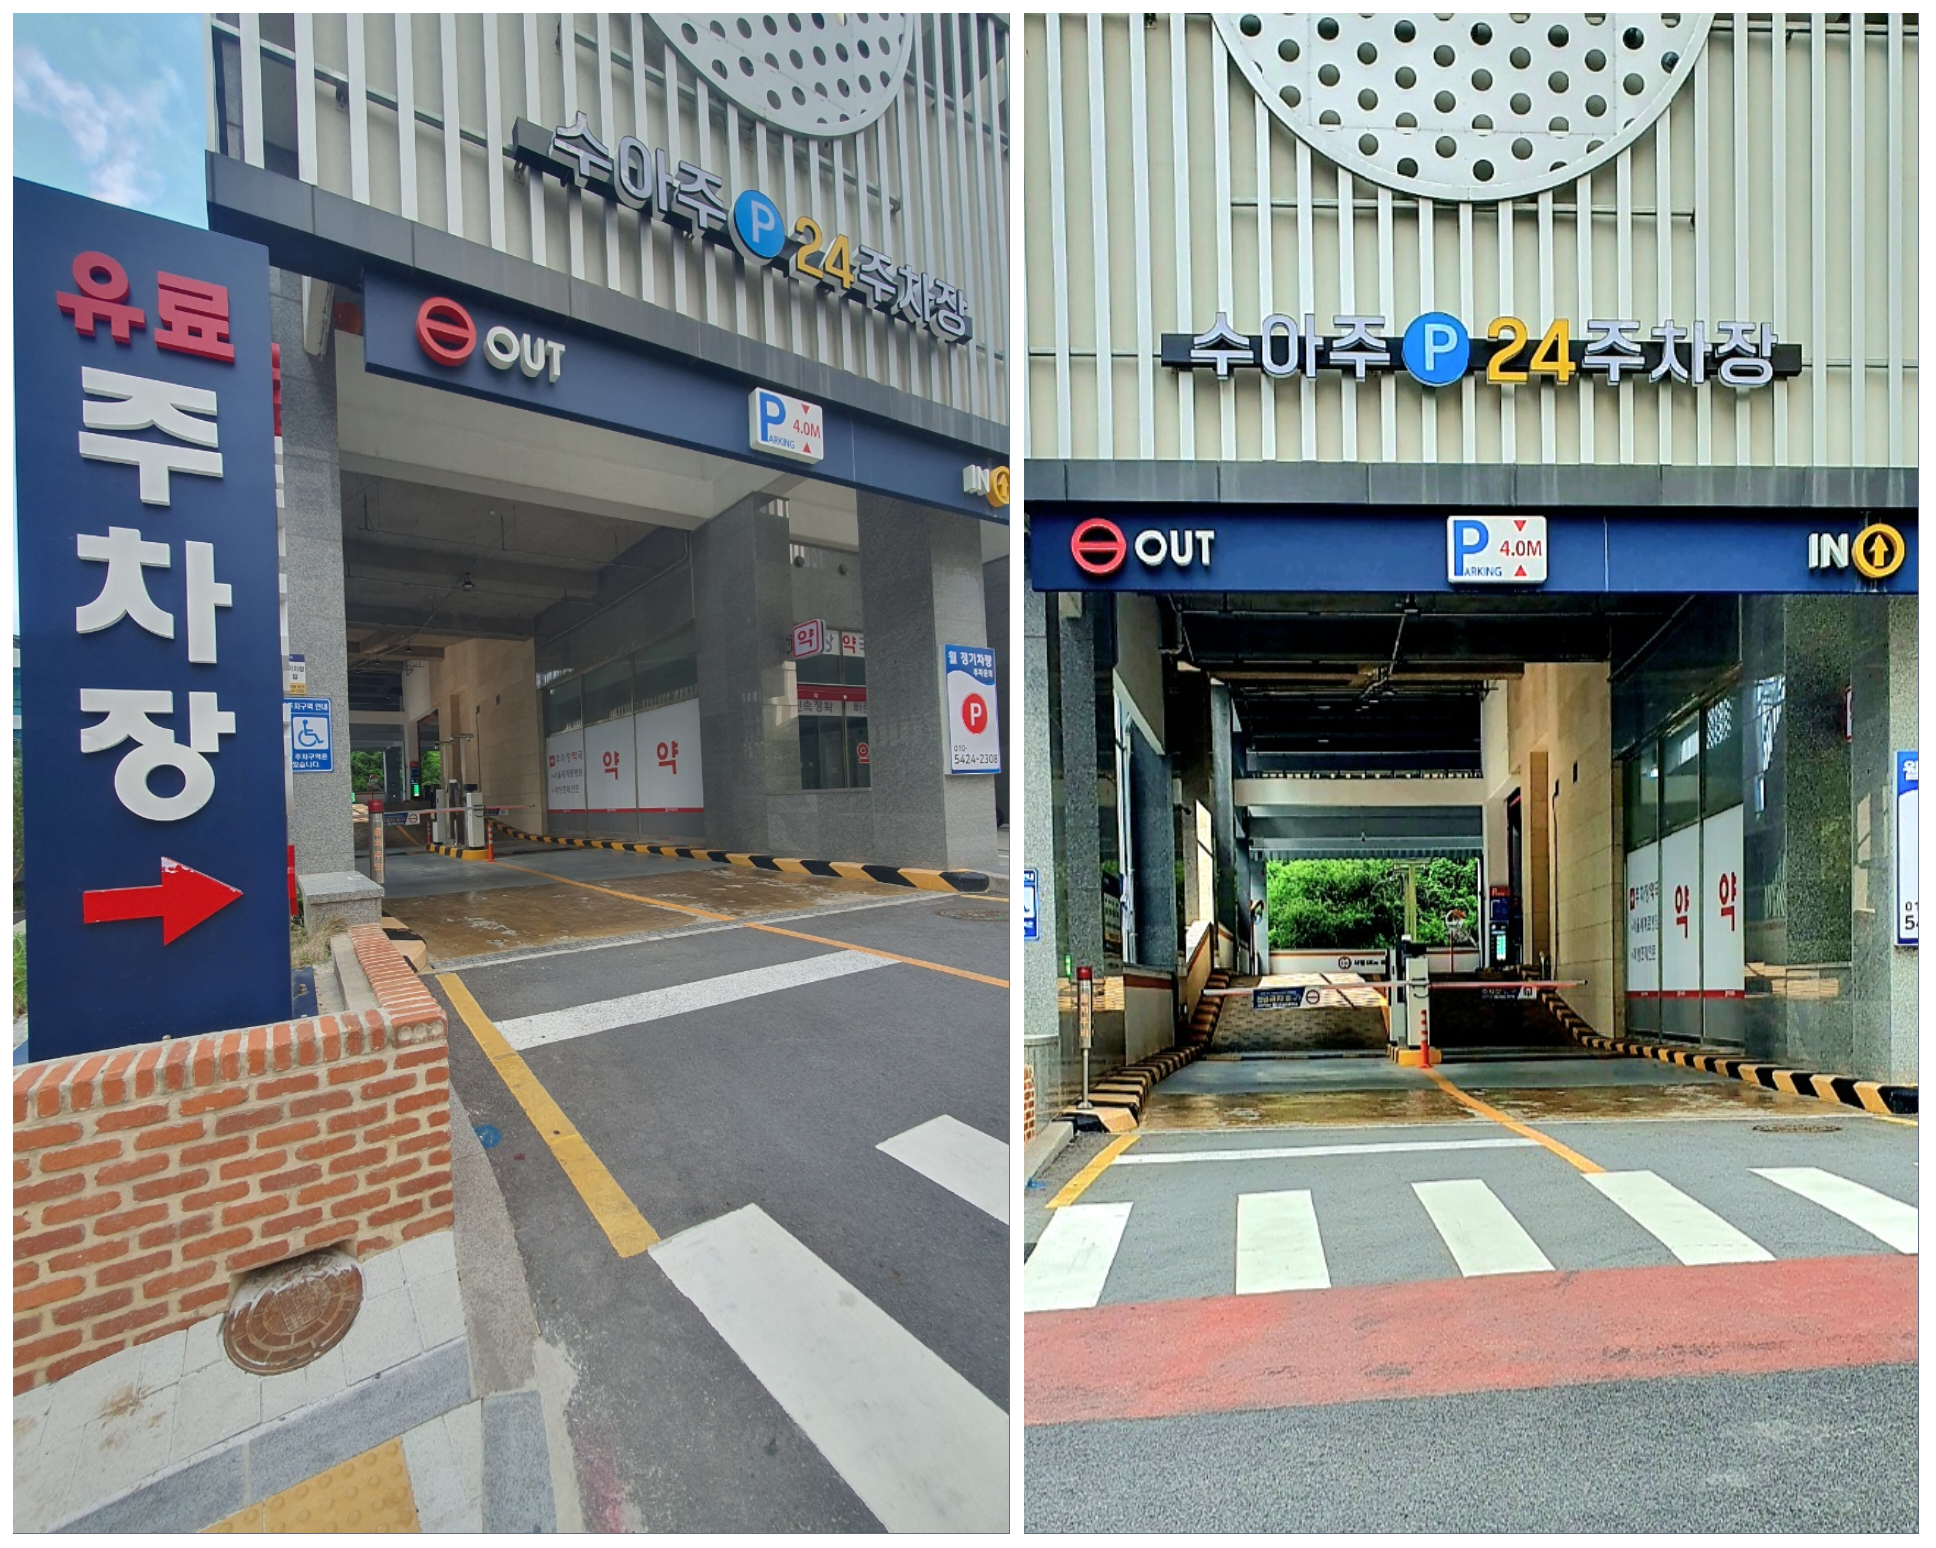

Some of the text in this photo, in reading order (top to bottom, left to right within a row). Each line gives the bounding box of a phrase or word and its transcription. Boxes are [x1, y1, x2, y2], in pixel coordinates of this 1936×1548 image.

[549, 111, 728, 242] 수아주
[56, 251, 235, 363] 유료
[483, 325, 566, 383] OUT
[1190, 311, 1391, 382] 수아주
[793, 419, 821, 439] 4.0M
[963, 464, 990, 496] IN
[1134, 529, 1215, 567] OUT
[1500, 540, 1542, 557] 4.0M
[1808, 532, 1849, 569] IN
[76, 366, 237, 822] 주차장
[798, 628, 814, 648] 약
[970, 703, 982, 726] P
[602, 751, 620, 780] 약
[656, 740, 679, 775] 약
[954, 753, 998, 765] 5424-2308
[1675, 885, 1689, 939] 약
[1719, 871, 1737, 932] 약
